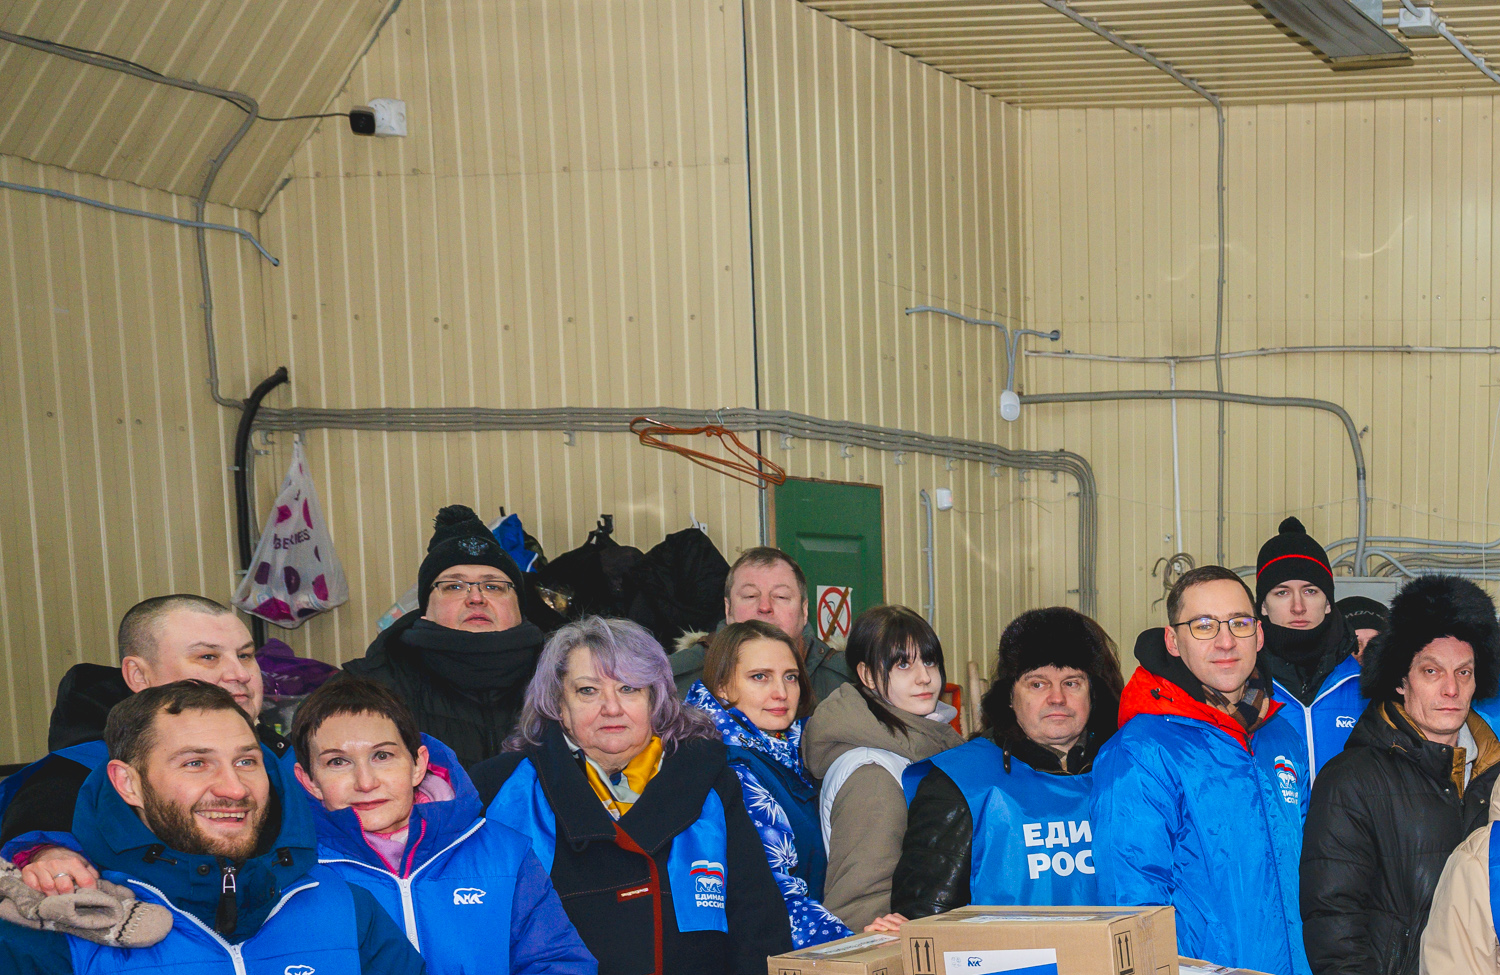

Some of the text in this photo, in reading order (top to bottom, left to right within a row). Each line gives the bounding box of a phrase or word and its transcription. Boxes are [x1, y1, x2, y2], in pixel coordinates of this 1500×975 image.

[1023, 820, 1093, 848] ЕДИ
[1027, 850, 1095, 879] РОС
[696, 901, 725, 909] РОССИЯ
